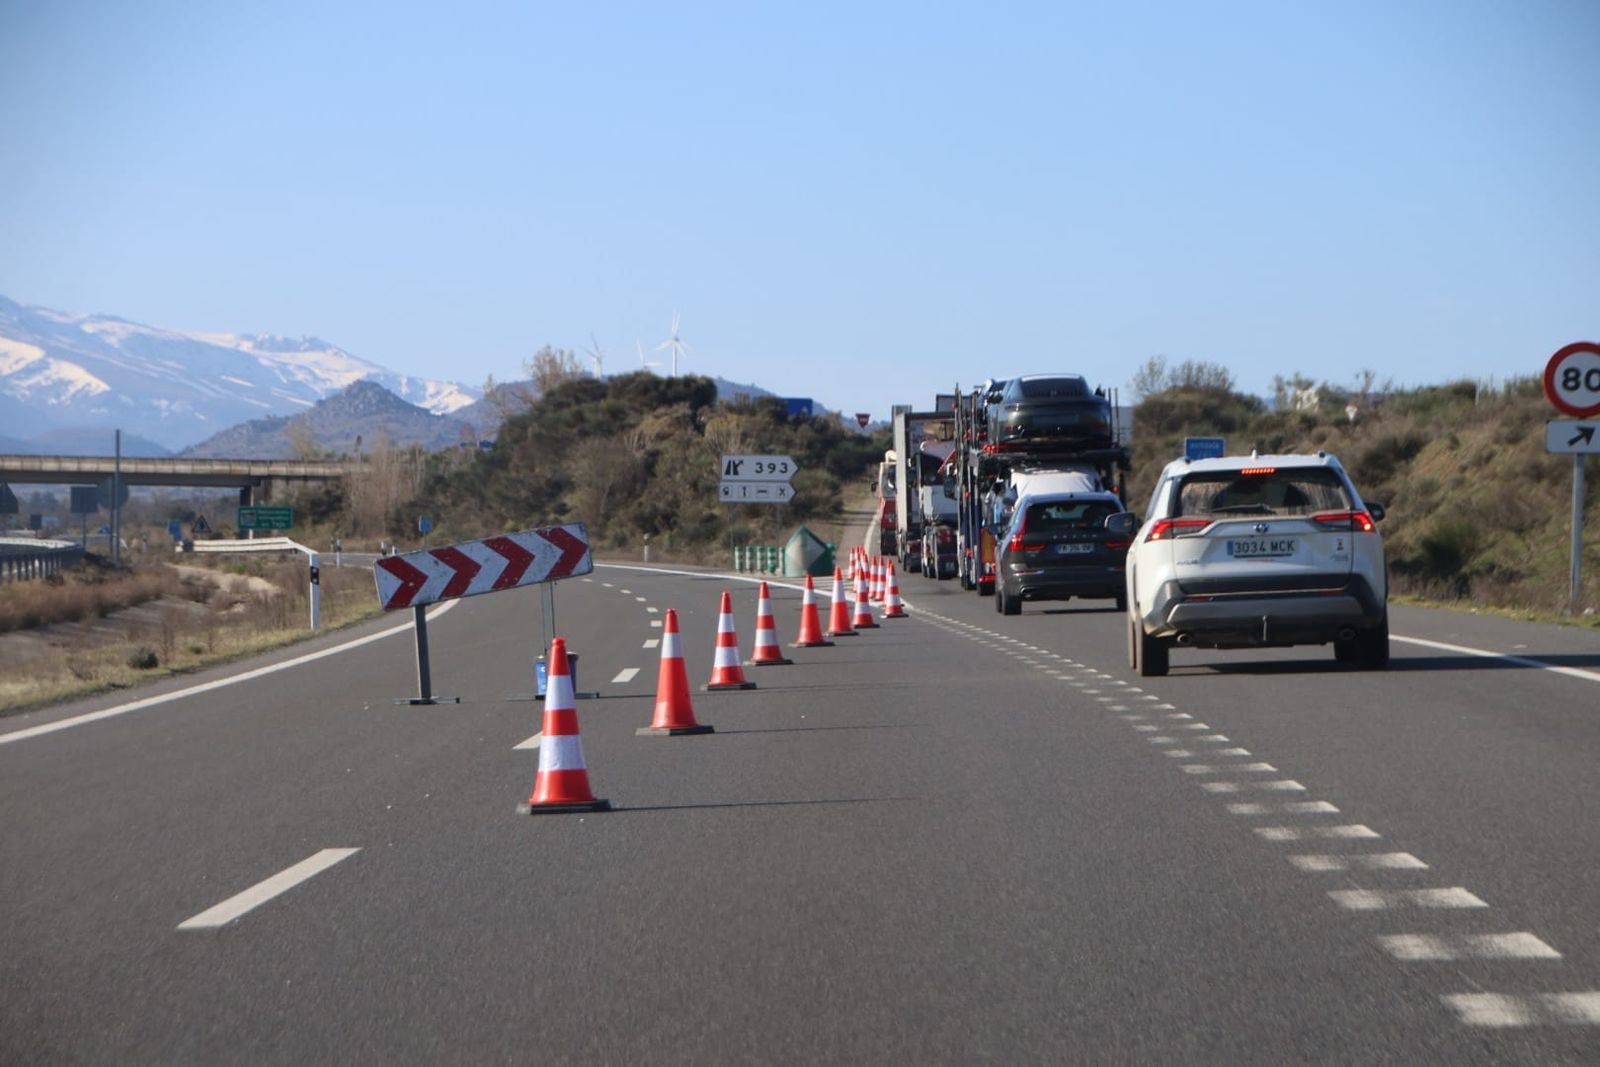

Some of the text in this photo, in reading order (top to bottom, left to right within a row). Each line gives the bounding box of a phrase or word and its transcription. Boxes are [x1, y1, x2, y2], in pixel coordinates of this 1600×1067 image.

[1562, 367, 1600, 392] 80
[754, 462, 788, 474] 393
[1234, 540, 1295, 553] 3034 MCK
